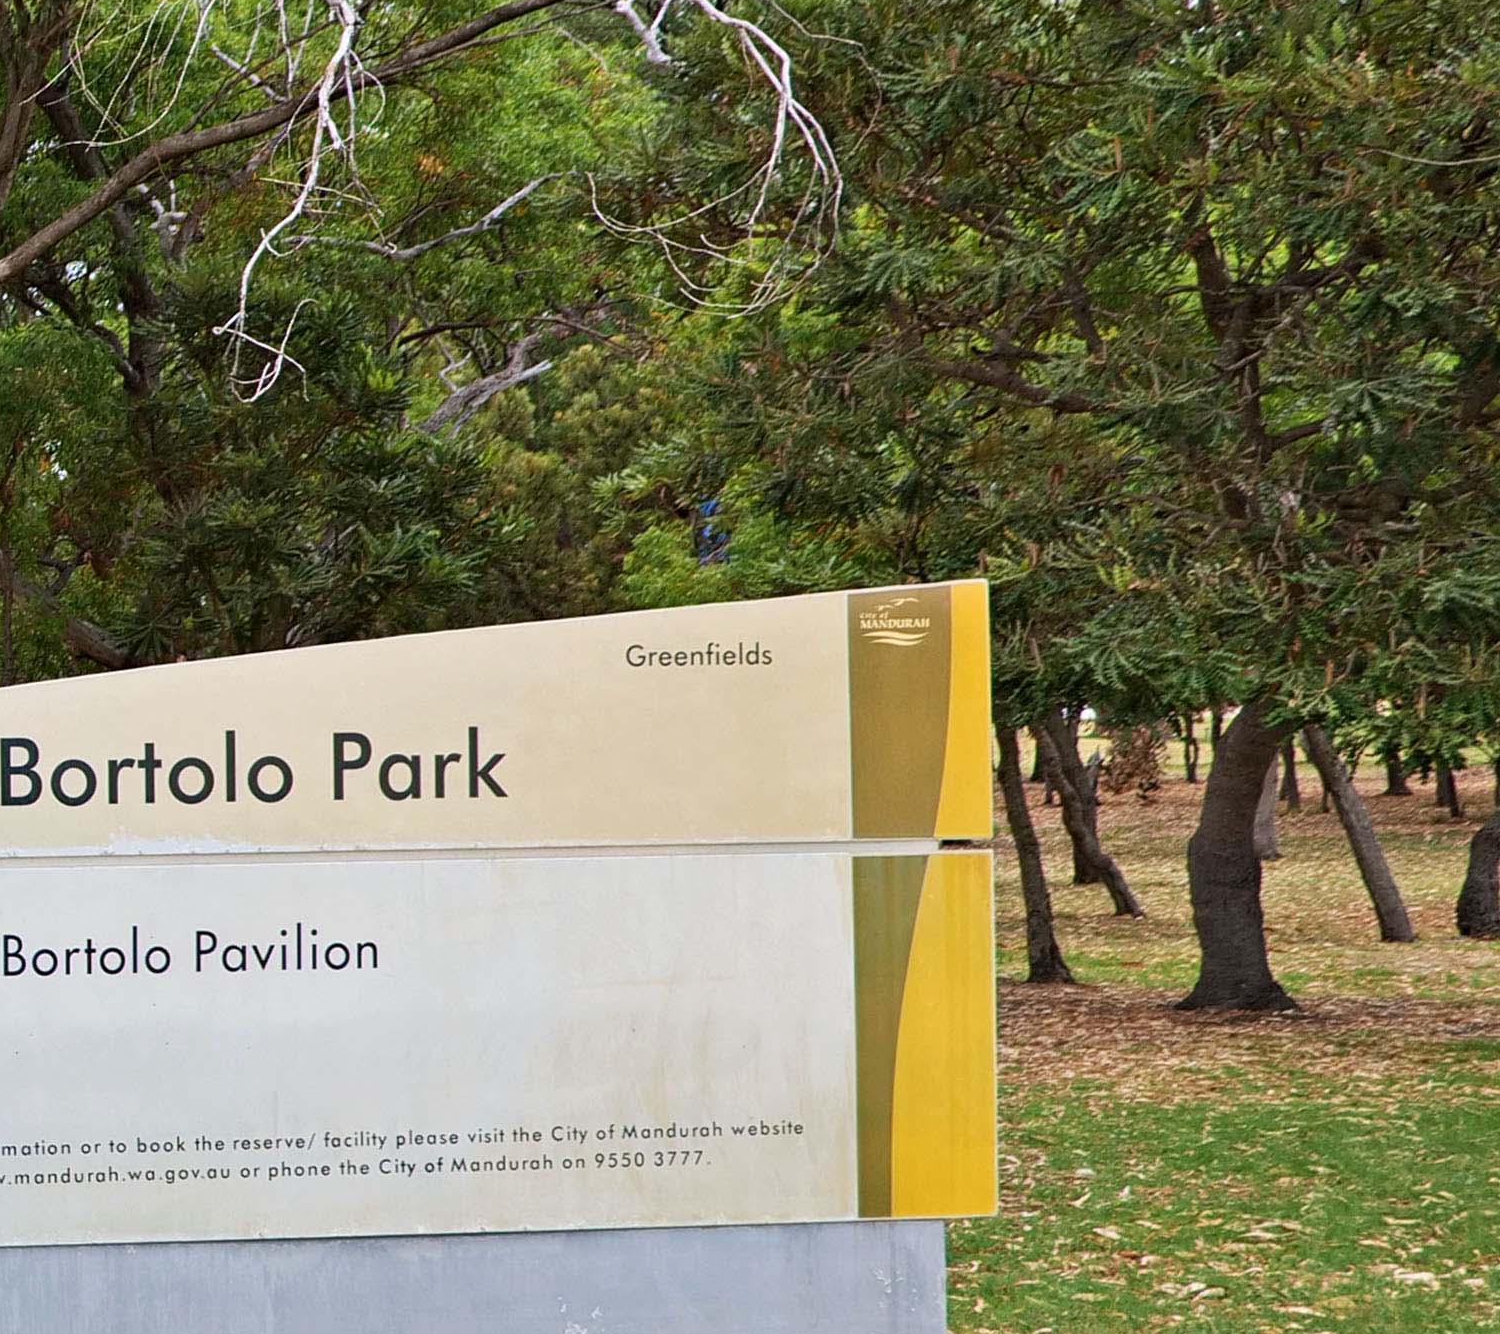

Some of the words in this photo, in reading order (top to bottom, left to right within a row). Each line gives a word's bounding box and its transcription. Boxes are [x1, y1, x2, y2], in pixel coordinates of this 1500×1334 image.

[860, 617, 930, 629] MANDURAH
[626, 642, 772, 667] Greenfields
[0, 730, 293, 806] Bortolo
[333, 727, 507, 801] Park
[4, 926, 170, 976] Bortolo
[196, 923, 377, 972] Pavilion
[81, 1144, 101, 1154] or
[109, 1141, 126, 1153] to
[137, 1136, 185, 1153] book
[195, 1136, 224, 1151] the
[234, 1134, 315, 1150] reserve/
[324, 1131, 387, 1149] facility
[396, 1130, 458, 1149] please
[468, 1128, 504, 1143] visit
[513, 1127, 542, 1142] the
[552, 1126, 587, 1144] City
[596, 1124, 614, 1140] of
[622, 1121, 722, 1139] Mandurah
[731, 1120, 803, 1136] website
[240, 1168, 260, 1178] or
[269, 1162, 330, 1181] phone
[339, 1160, 369, 1175] the
[379, 1159, 416, 1177] City
[425, 1157, 443, 1173] of
[451, 1155, 552, 1172] Mandurah
[563, 1159, 585, 1169] on
[595, 1152, 644, 1168] 9550
